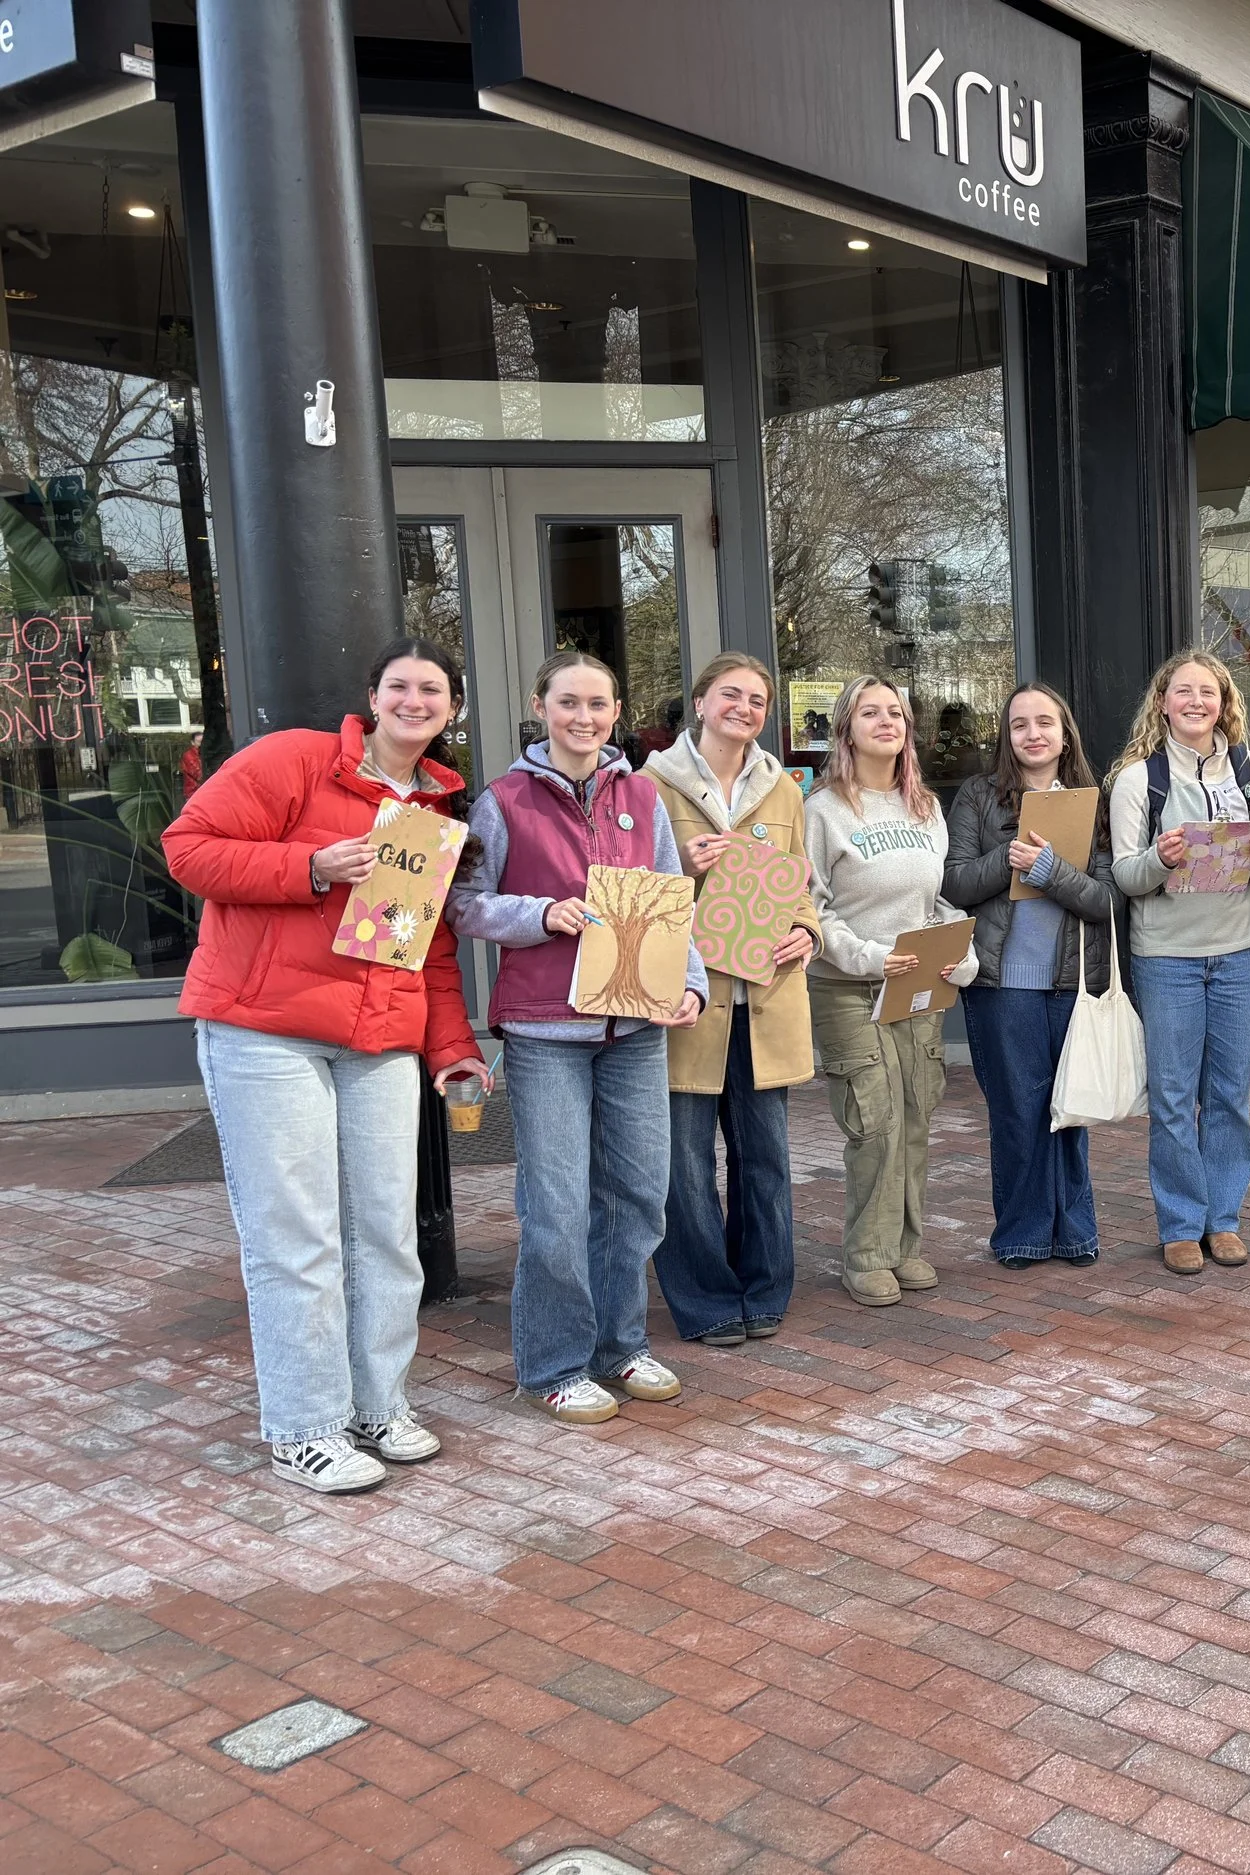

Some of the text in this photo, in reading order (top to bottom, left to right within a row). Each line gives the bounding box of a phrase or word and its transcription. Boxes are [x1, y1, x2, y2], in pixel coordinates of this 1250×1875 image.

[958, 177, 1040, 226] coffee
[861, 820, 907, 836] UNIVERSITY
[378, 842, 427, 875] CAC
[858, 829, 939, 861] VERMONT
